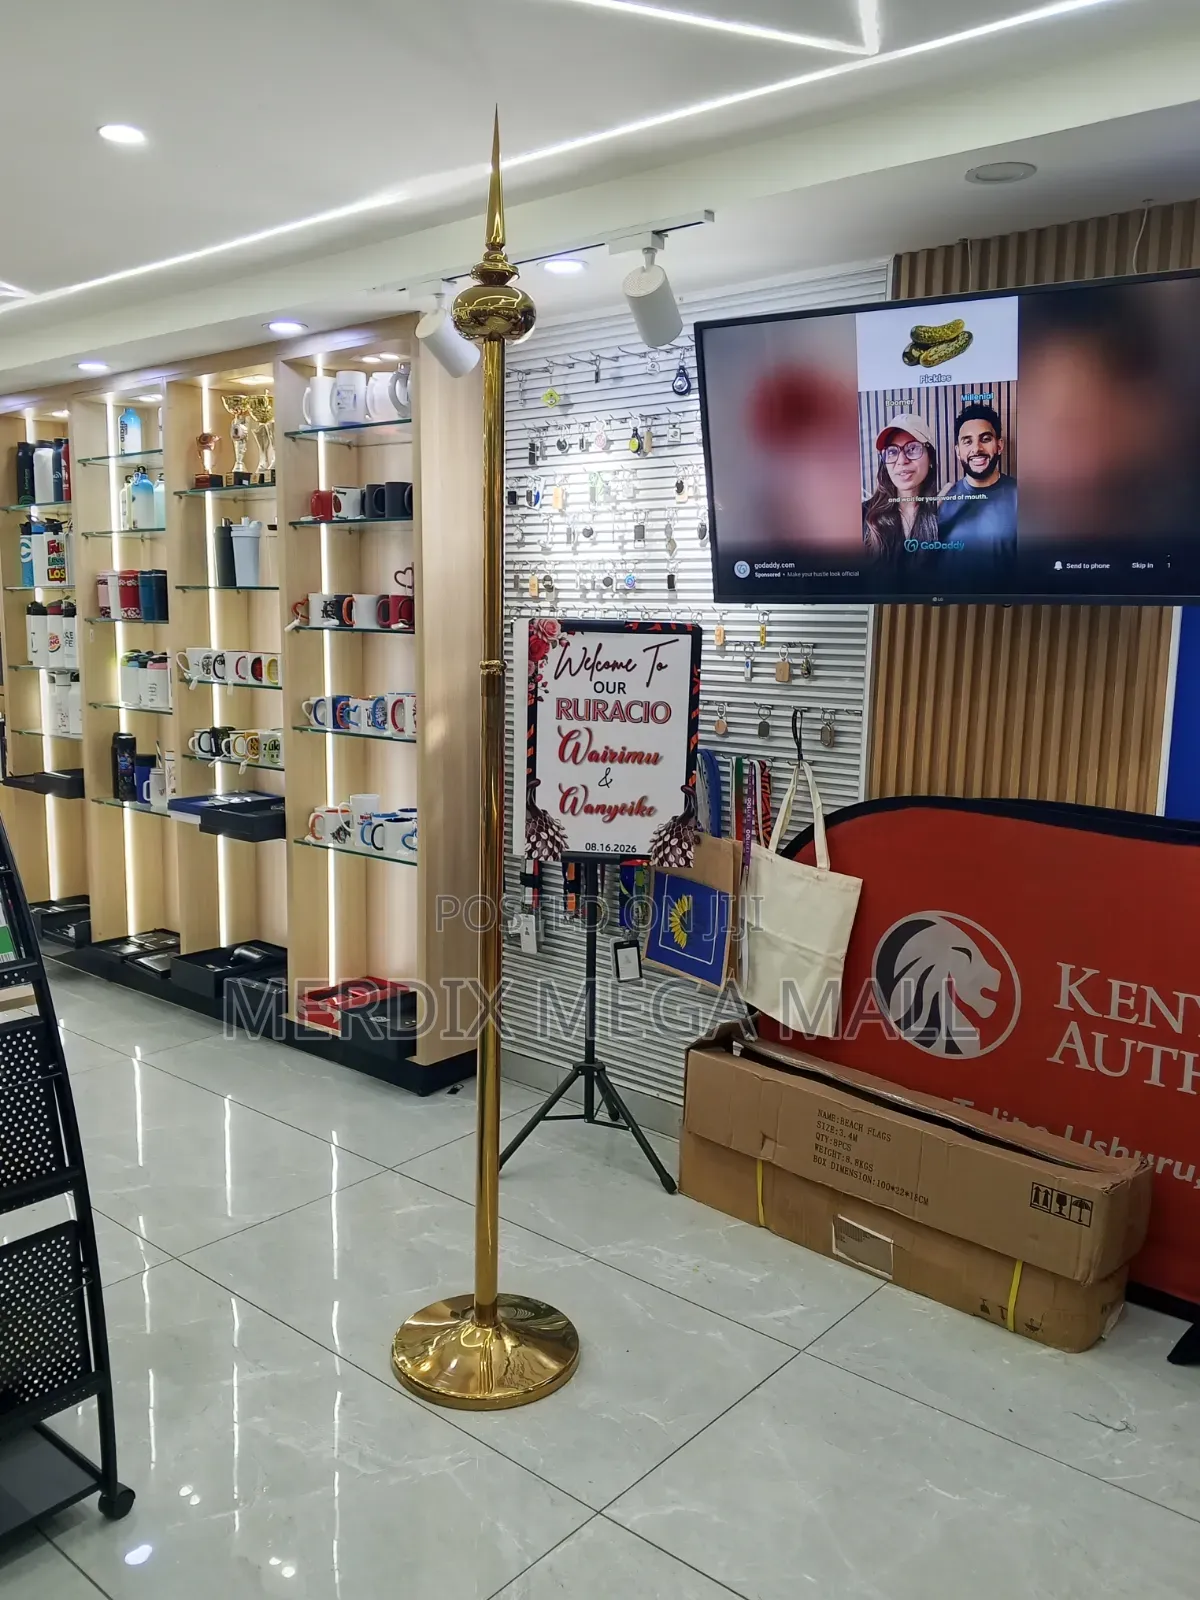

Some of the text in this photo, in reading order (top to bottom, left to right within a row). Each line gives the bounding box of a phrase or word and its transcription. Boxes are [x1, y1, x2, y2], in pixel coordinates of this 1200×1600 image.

[919, 374, 952, 384] Pickles
[885, 399, 915, 407] Boomer
[961, 392, 994, 402] Millenial
[920, 540, 965, 551] GoDaddy
[754, 562, 795, 570] godaddy.com
[1131, 562, 1146, 570] Skip
[554, 638, 680, 687] Welcome To
[593, 681, 627, 694] OUR
[555, 697, 672, 724] RURACIO
[557, 725, 663, 766] Wairimu
[598, 767, 613, 788] &
[585, 842, 637, 853] 08.16.2026
[1053, 961, 1200, 1038] KEN
[817, 1109, 892, 1142] NAME:BEACH FLAGS
[815, 1132, 852, 1151] QTY:8PCS
[812, 1155, 827, 1167] BOX
